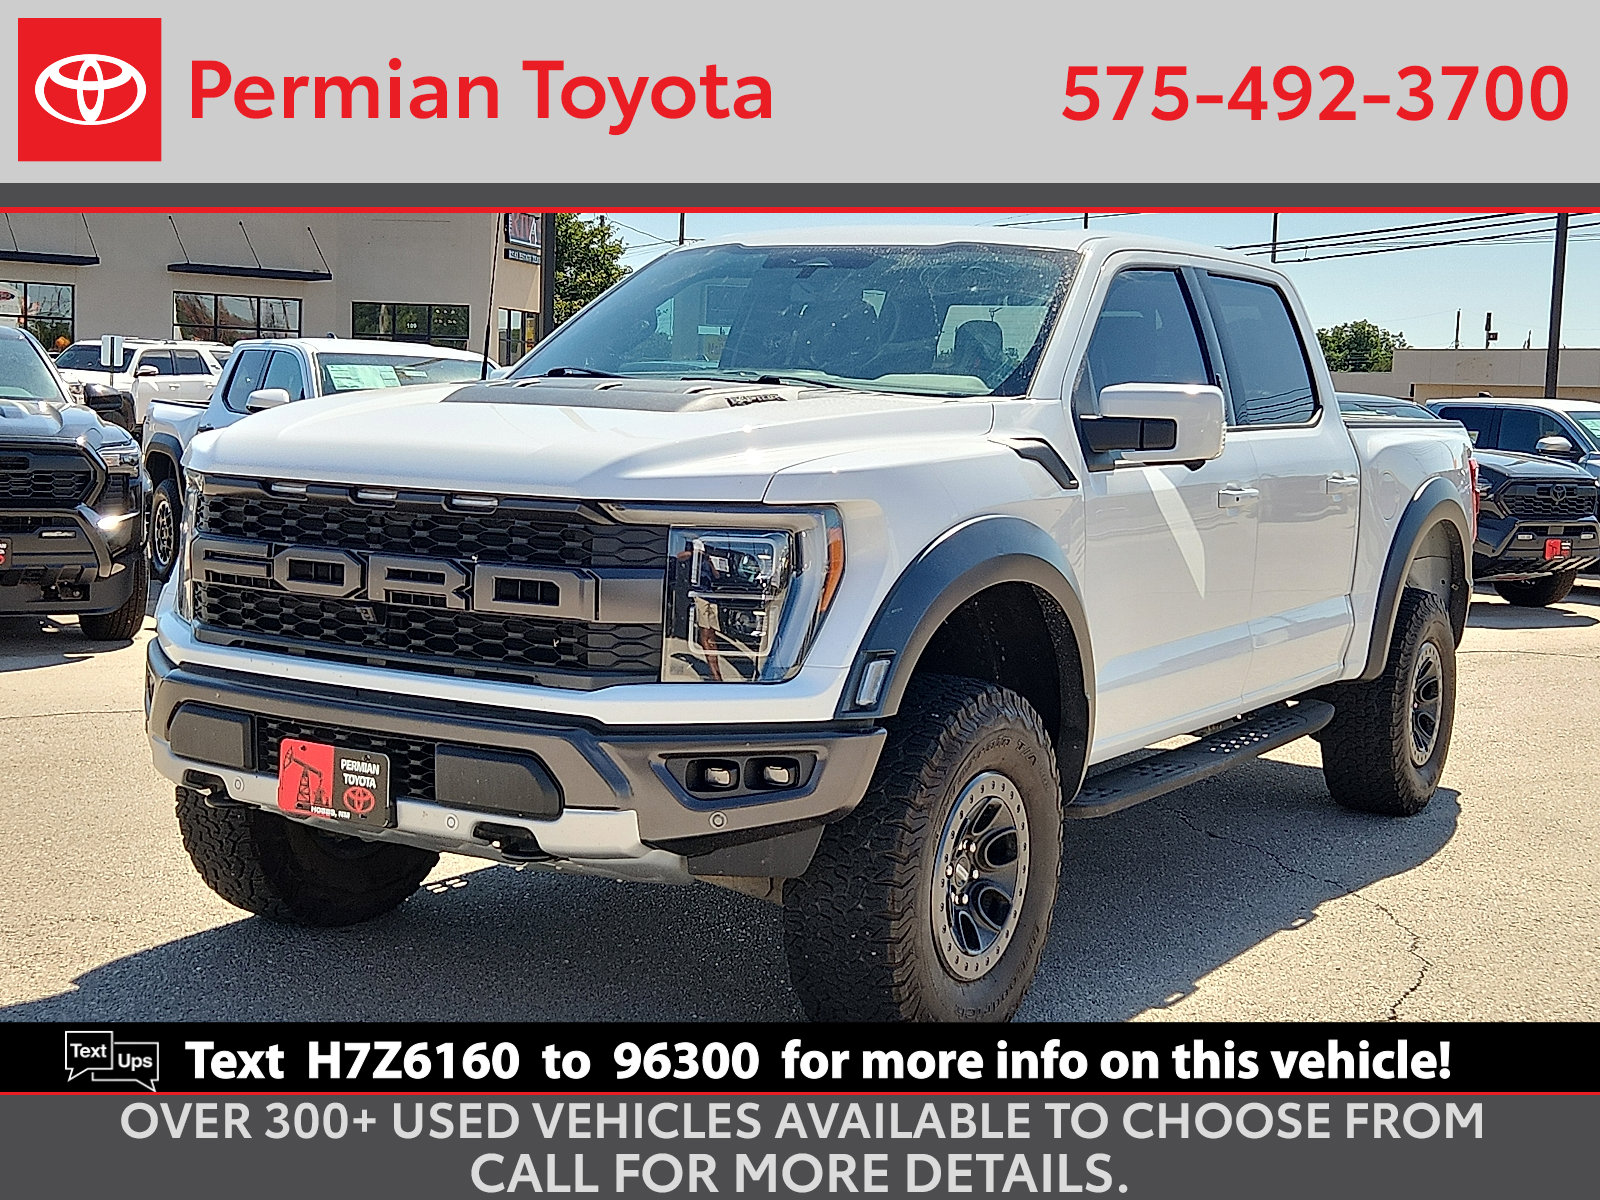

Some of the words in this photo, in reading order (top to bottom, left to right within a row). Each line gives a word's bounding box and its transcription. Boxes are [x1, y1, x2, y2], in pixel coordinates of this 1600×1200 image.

[191, 537, 597, 622] FORD
[341, 758, 380, 775] PERMIAN
[343, 773, 376, 789] TOYOTA
